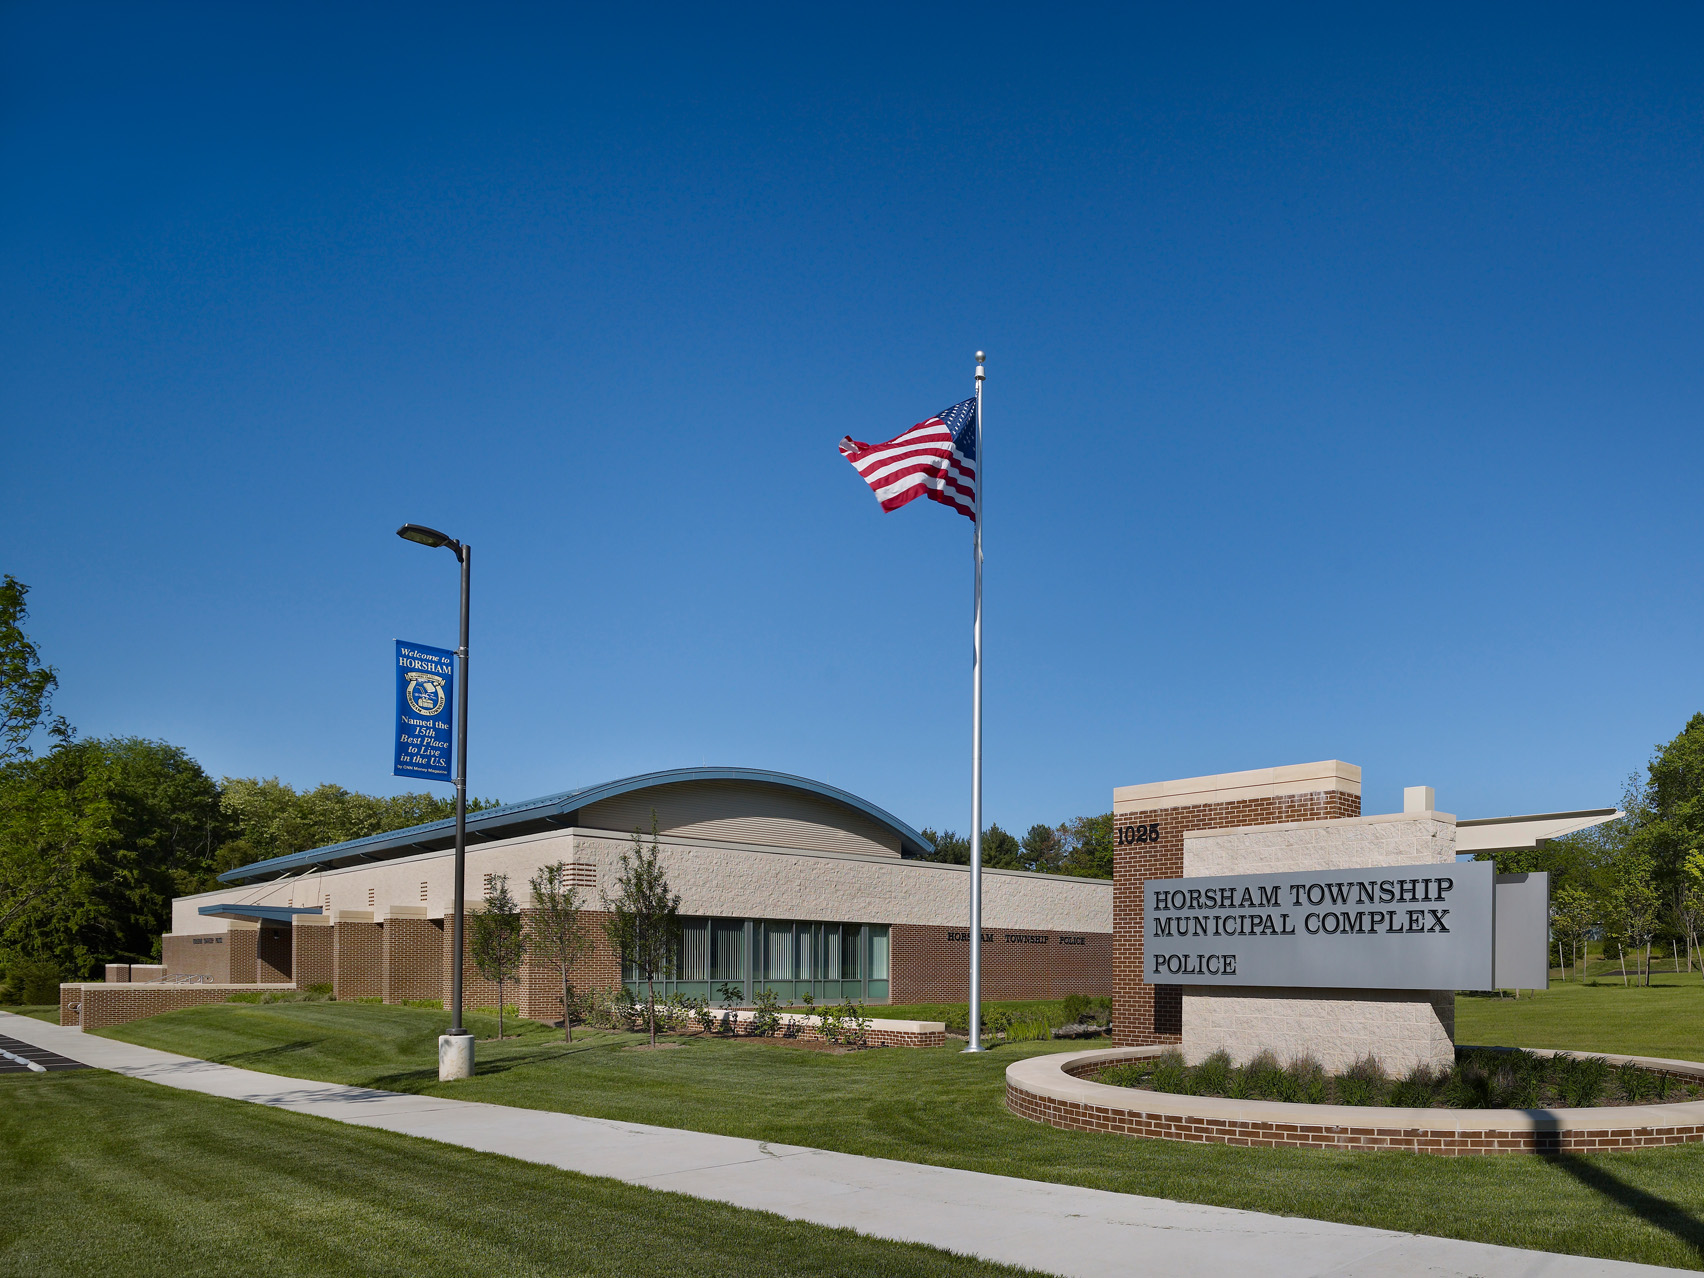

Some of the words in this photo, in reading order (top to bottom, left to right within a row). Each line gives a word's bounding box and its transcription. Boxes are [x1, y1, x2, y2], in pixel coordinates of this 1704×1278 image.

[401, 647, 439, 663] Welcome
[441, 656, 450, 664] to
[399, 656, 452, 675] HORSHAM
[401, 715, 433, 728] Named
[435, 719, 449, 730] the
[414, 726, 435, 737] 15th
[400, 734, 421, 745] Best
[423, 737, 449, 749] Place
[408, 745, 418, 754] to
[420, 746, 441, 757] Live
[400, 753, 410, 763] in
[412, 754, 428, 765] the
[430, 757, 447, 767] U.S.
[1117, 823, 1160, 845] 1025
[1153, 885, 1282, 912] HORSHAM
[1289, 877, 1455, 907] TOWNSHIP
[1153, 913, 1296, 938] MUNICIPAL
[1303, 909, 1451, 936] COMPLEX
[947, 932, 994, 943] HORAM
[1004, 934, 1049, 945] TOWNSHIP
[1058, 936, 1086, 946] POLICE
[1153, 953, 1237, 976] POLICE
